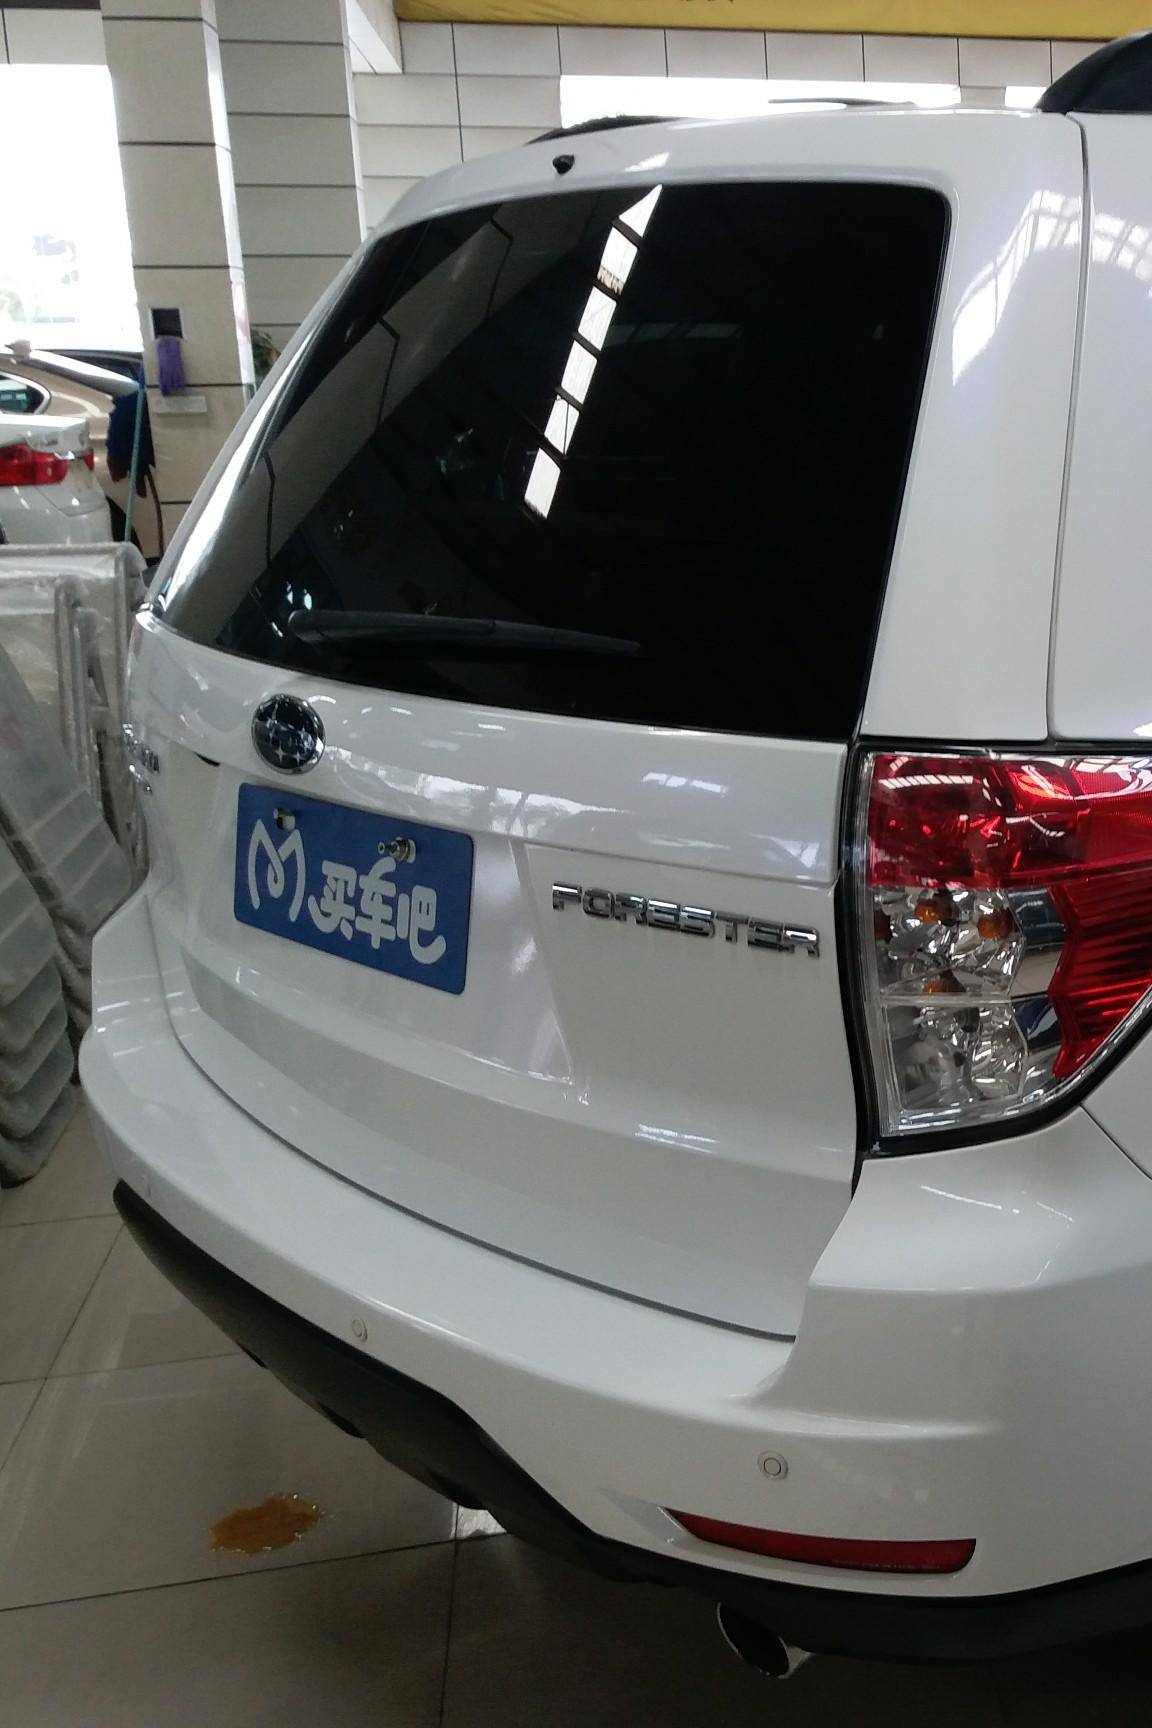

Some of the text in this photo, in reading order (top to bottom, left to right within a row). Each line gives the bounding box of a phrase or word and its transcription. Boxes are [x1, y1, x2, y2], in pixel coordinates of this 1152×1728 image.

[307, 856, 447, 965] 买车吧
[551, 881, 821, 958] FORESTER
